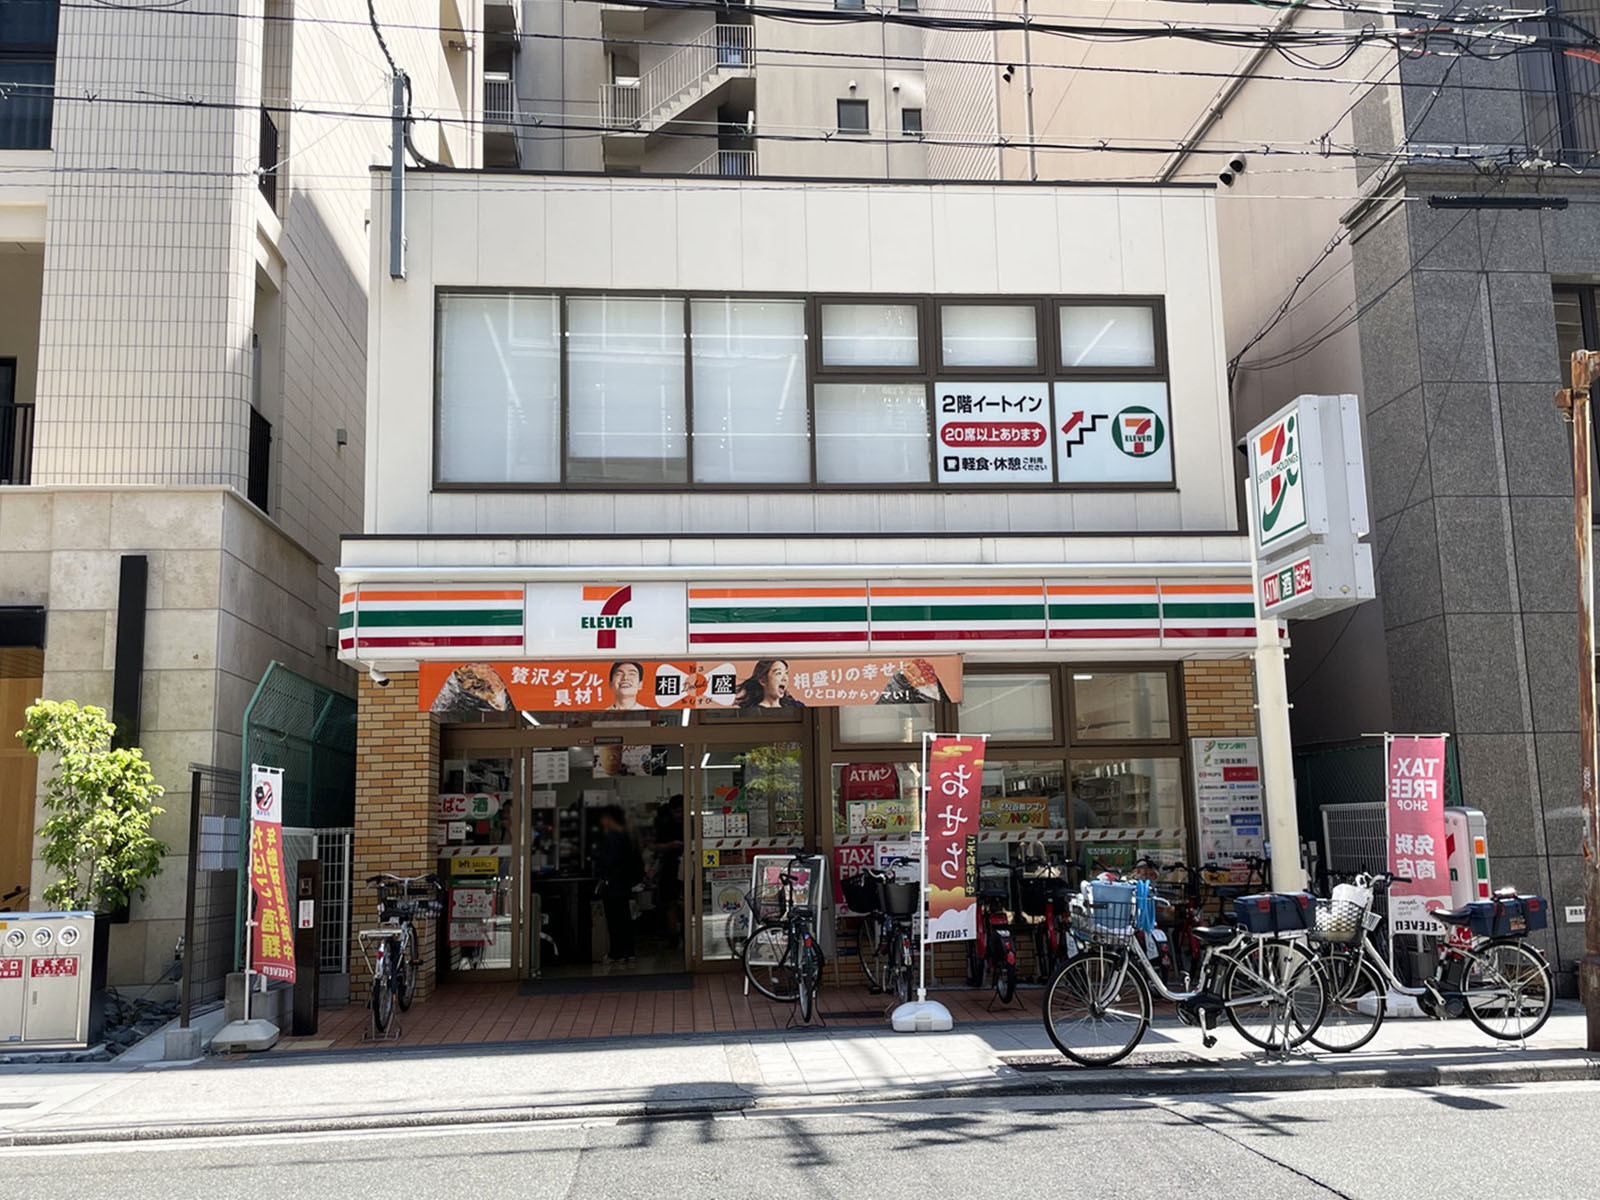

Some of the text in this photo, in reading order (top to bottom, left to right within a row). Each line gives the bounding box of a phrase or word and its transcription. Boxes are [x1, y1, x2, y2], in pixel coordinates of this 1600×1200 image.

[942, 395, 1042, 413] 2階イートイン
[945, 428, 1042, 441] 20席以上あります
[1265, 577, 1280, 602] ATM
[1281, 571, 1293, 598] 酒
[510, 666, 604, 686] 贅沢ダブル
